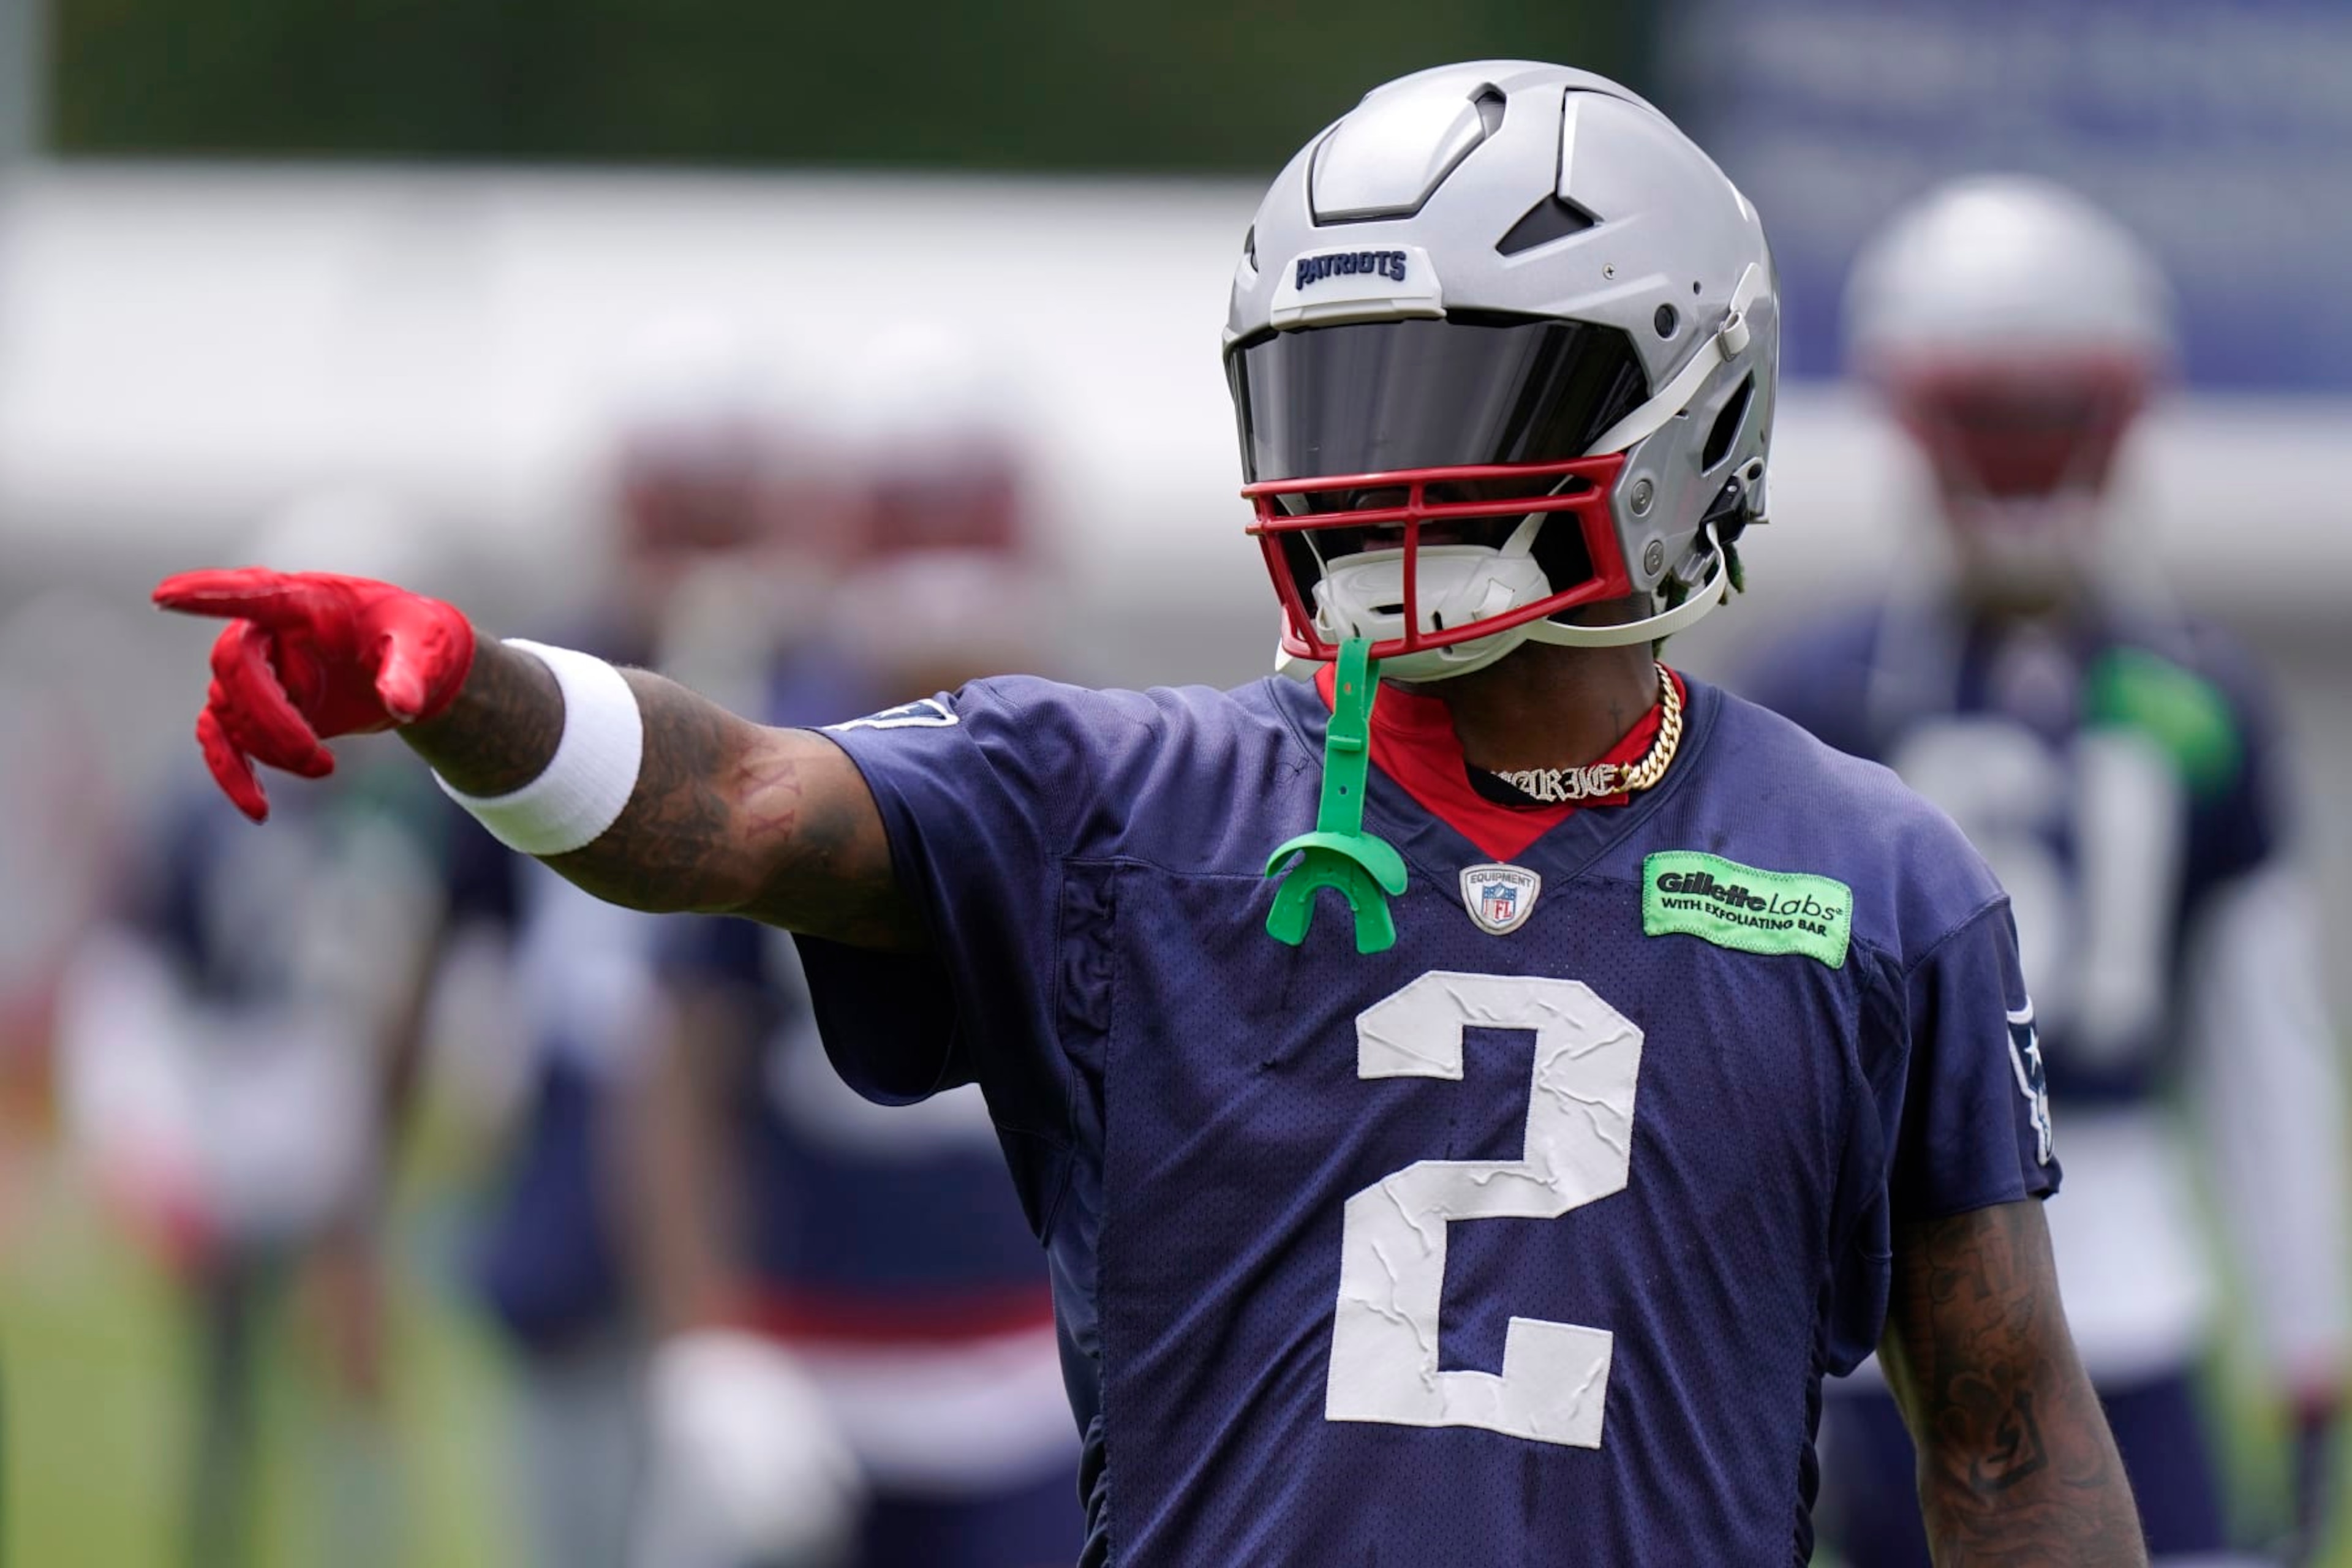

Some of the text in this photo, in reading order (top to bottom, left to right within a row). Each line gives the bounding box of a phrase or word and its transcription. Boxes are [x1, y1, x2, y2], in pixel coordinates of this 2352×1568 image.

[1295, 251, 1406, 290] PATRIOTS
[1470, 872, 1531, 888] EQUIPMENT
[1661, 897, 1827, 937] WITH EXFOLIATING BAR
[1325, 970, 1645, 1449] 2
